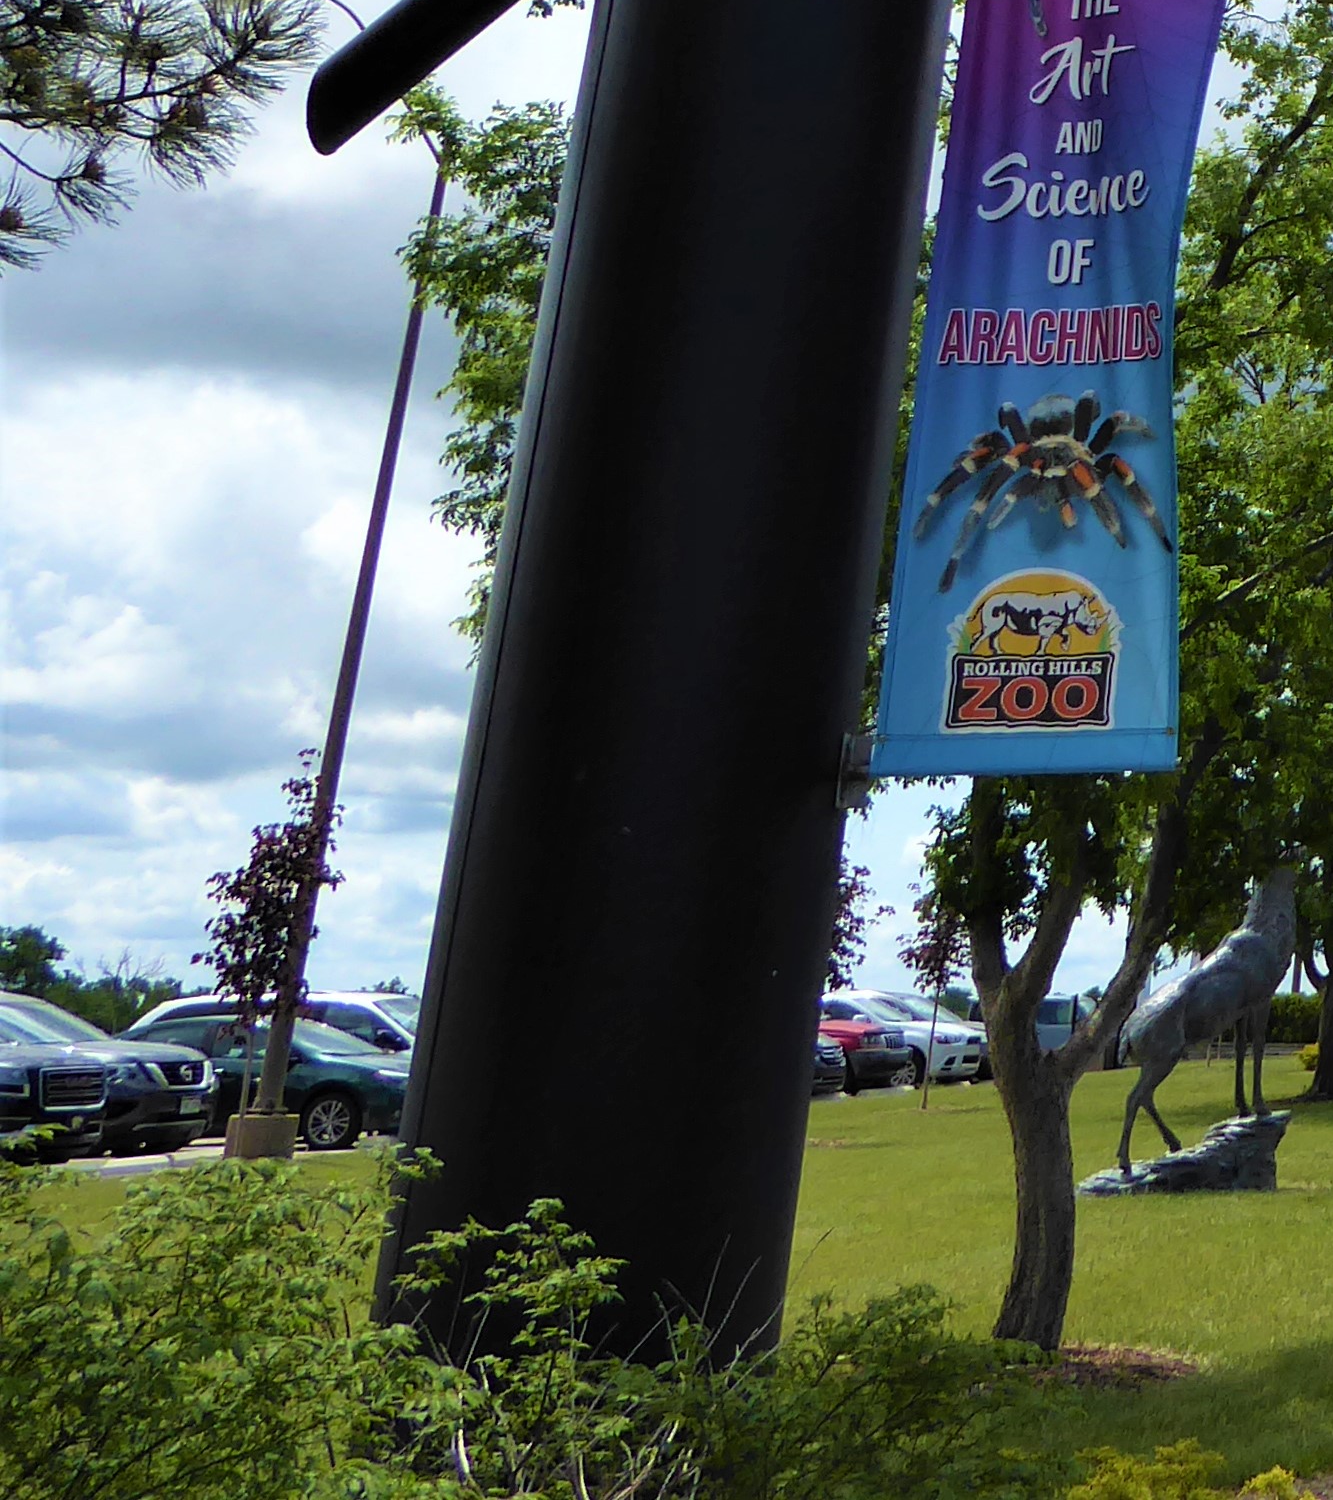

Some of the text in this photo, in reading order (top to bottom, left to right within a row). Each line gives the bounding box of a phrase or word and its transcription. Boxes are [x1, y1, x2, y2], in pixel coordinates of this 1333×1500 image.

[1029, 36, 1136, 104] Art
[1055, 119, 1103, 154] AND
[977, 153, 1149, 222] Science
[1047, 239, 1094, 285] OF
[938, 302, 1163, 366] ARACHNIDS
[963, 661, 1102, 676] ROLLING HILLS
[959, 676, 1099, 719] ZOO
